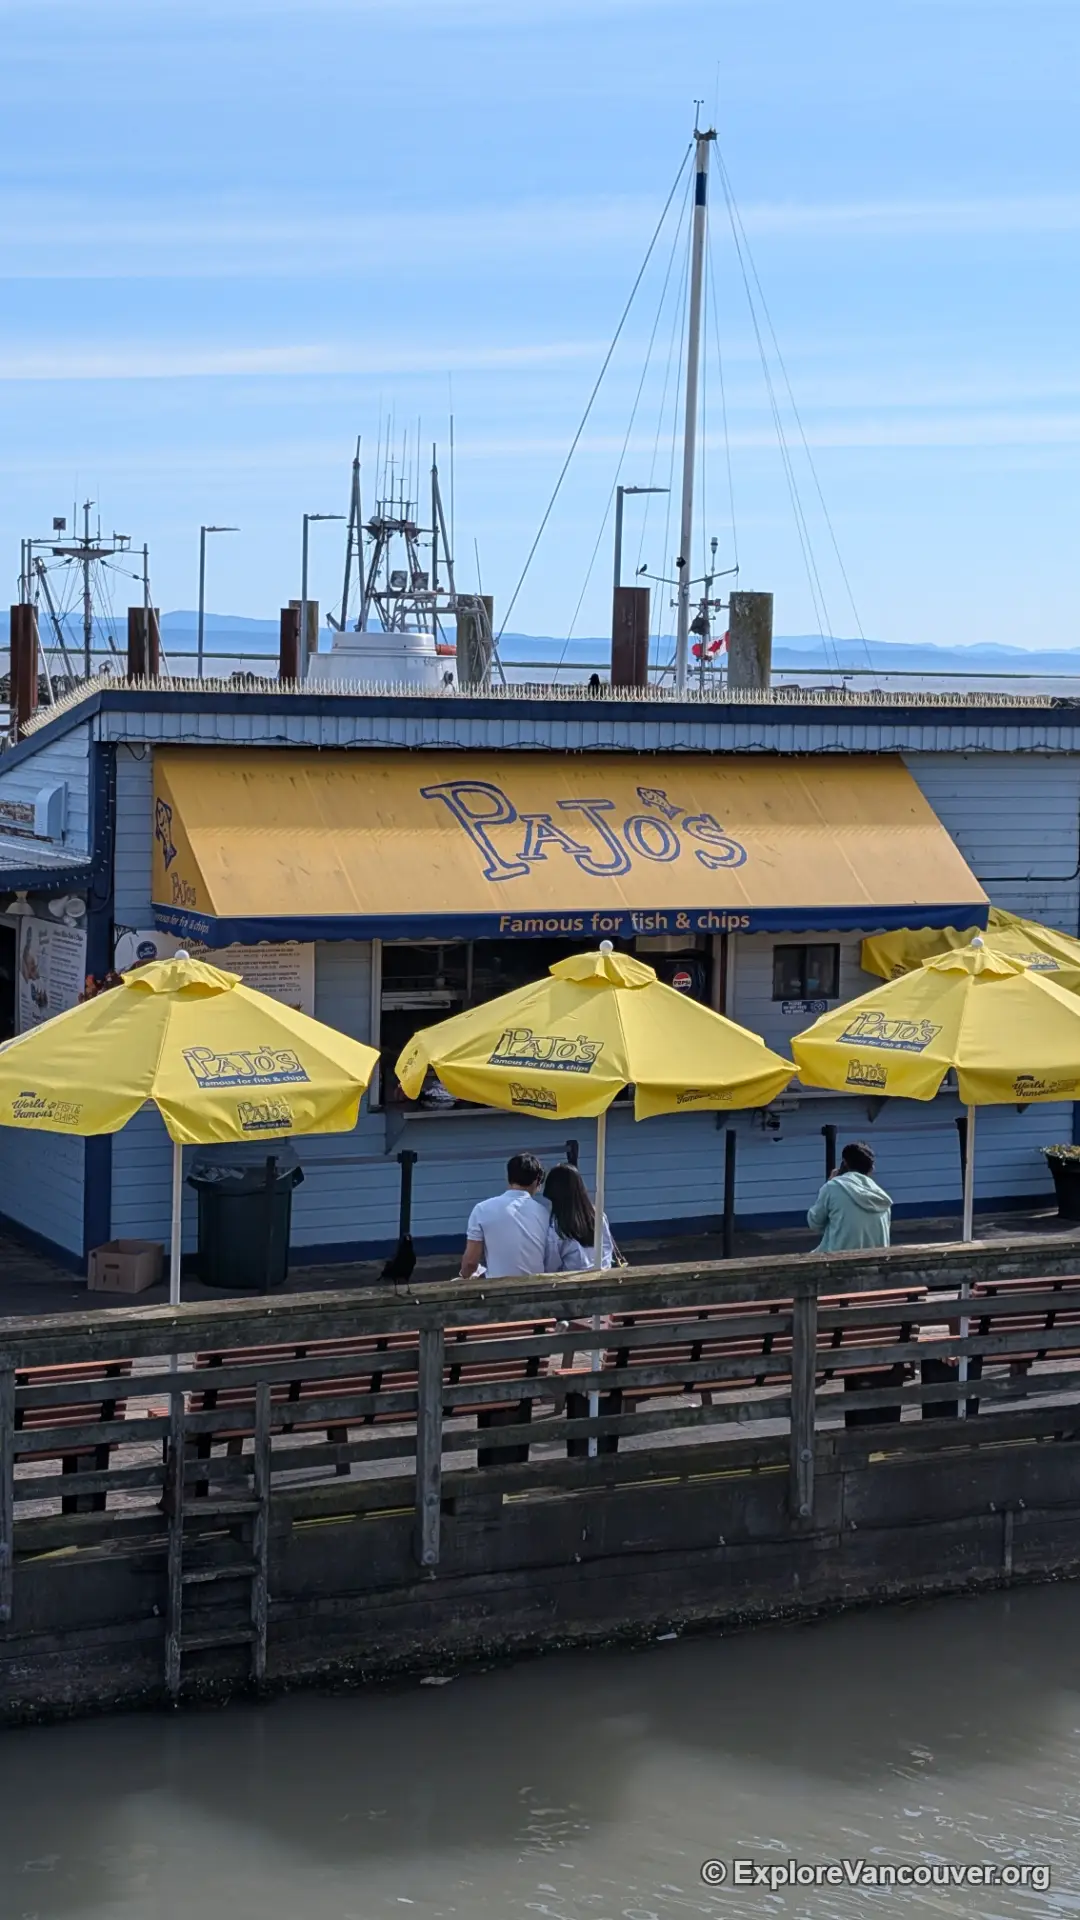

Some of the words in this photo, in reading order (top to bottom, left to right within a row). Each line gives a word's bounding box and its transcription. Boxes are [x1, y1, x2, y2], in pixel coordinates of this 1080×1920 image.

[500, 916, 583, 932] Famous
[591, 914, 623, 931] for
[631, 912, 668, 930] fish
[676, 913, 691, 928] &
[697, 911, 750, 931] chips
[489, 1057, 522, 1066] Famous
[540, 1061, 555, 1069] fish
[566, 1062, 589, 1073] chips
[282, 1074, 307, 1084] chips
[12, 1098, 47, 1109] World
[13, 1109, 53, 1119] Famous
[54, 1112, 79, 1124] CHIPS
